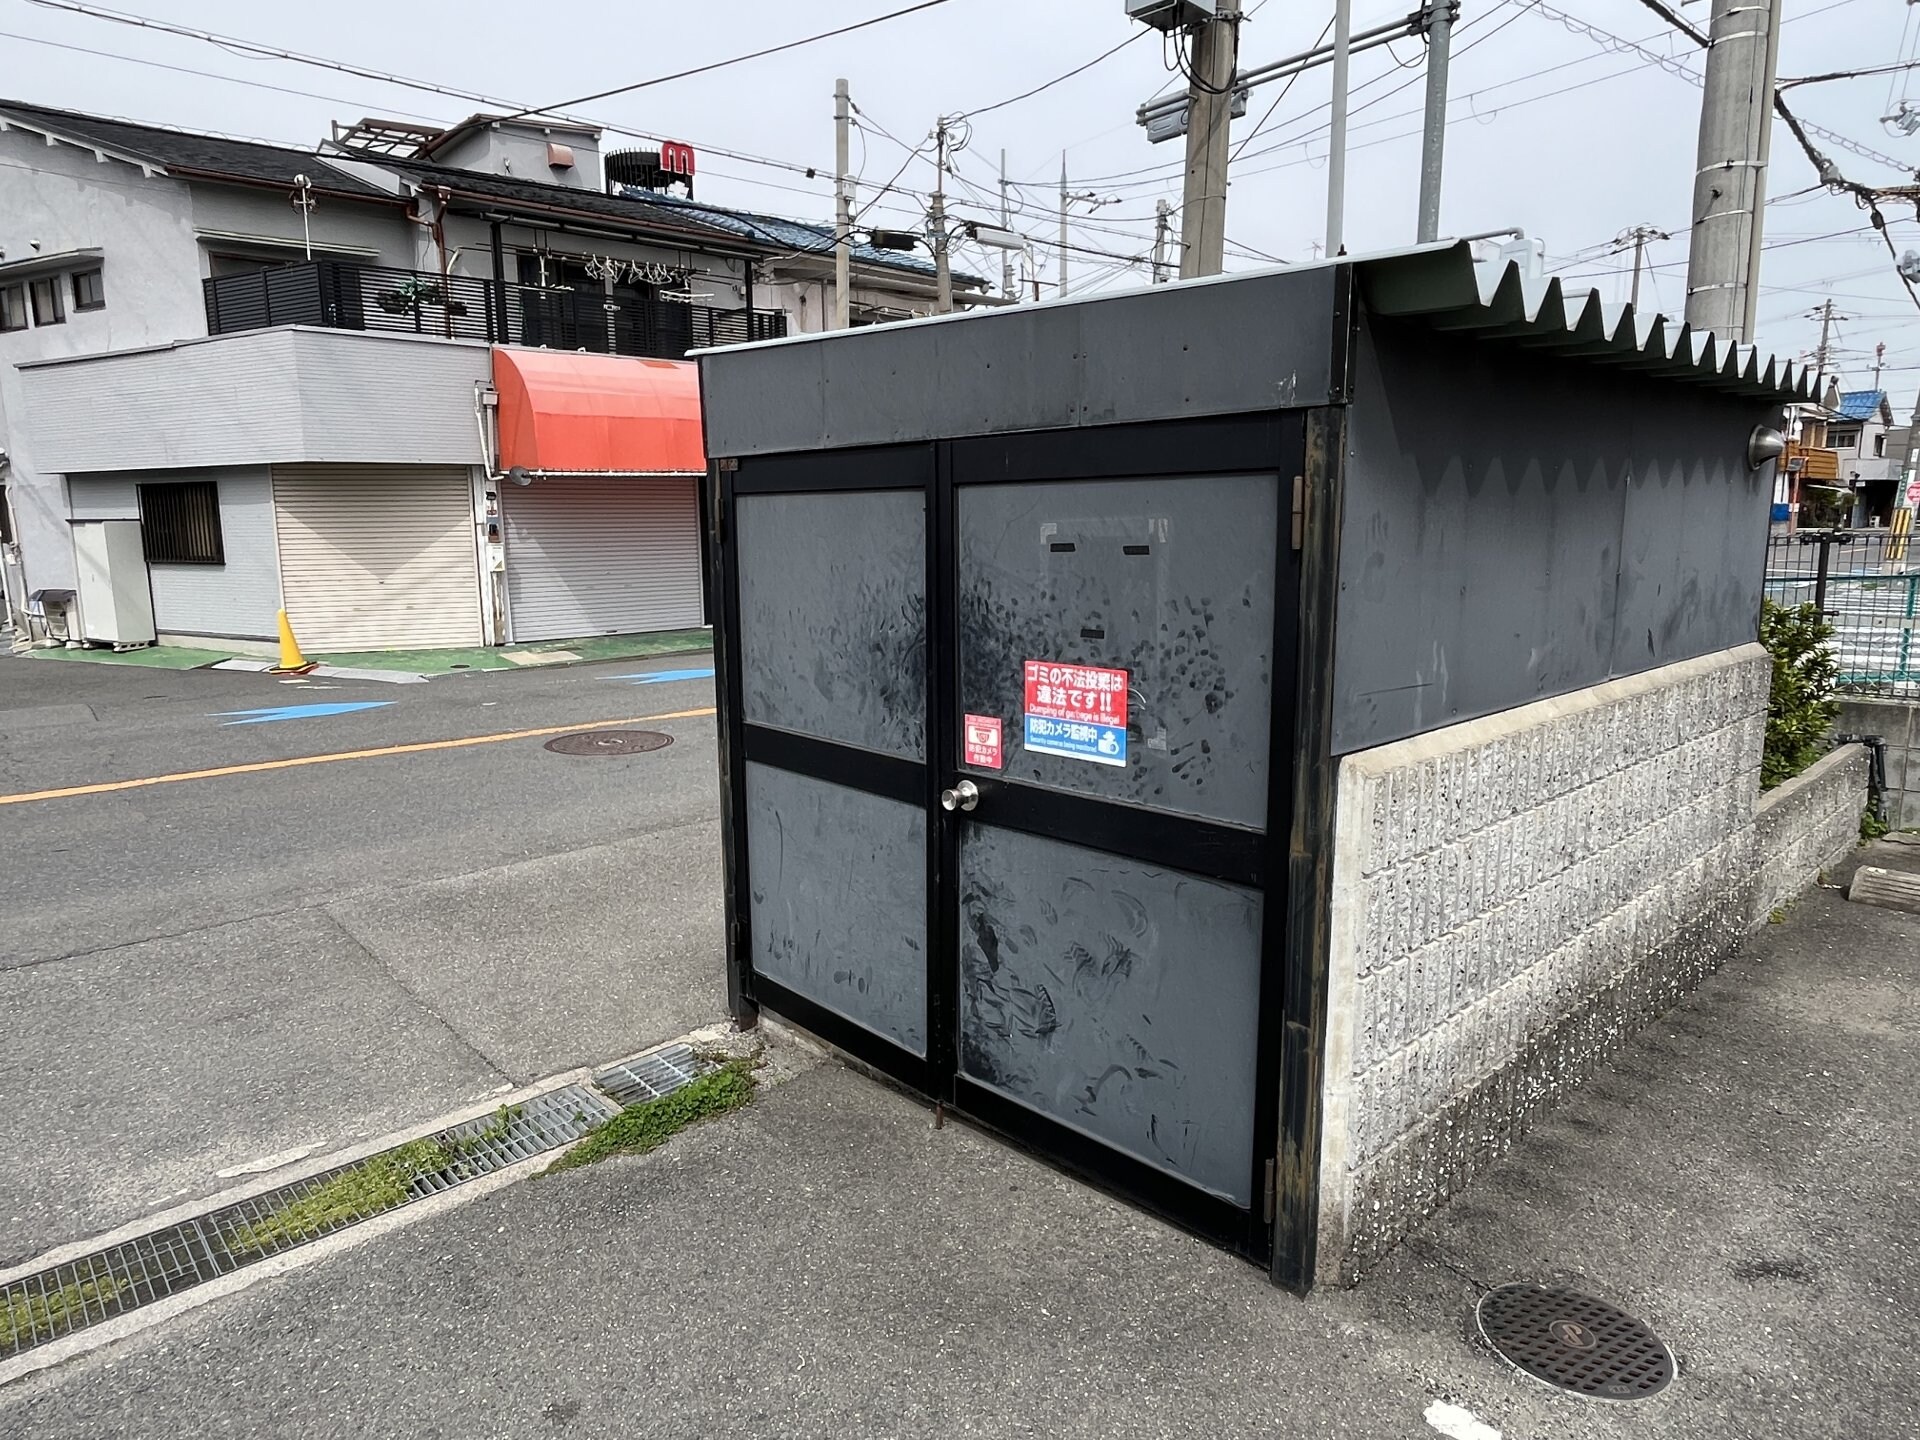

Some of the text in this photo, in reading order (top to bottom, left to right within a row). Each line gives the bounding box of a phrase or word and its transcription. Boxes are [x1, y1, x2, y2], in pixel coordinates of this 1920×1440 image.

[1027, 664, 1123, 692] ゴミの不法投棄は
[1029, 717, 1098, 743] 防犯カメラ監視中
